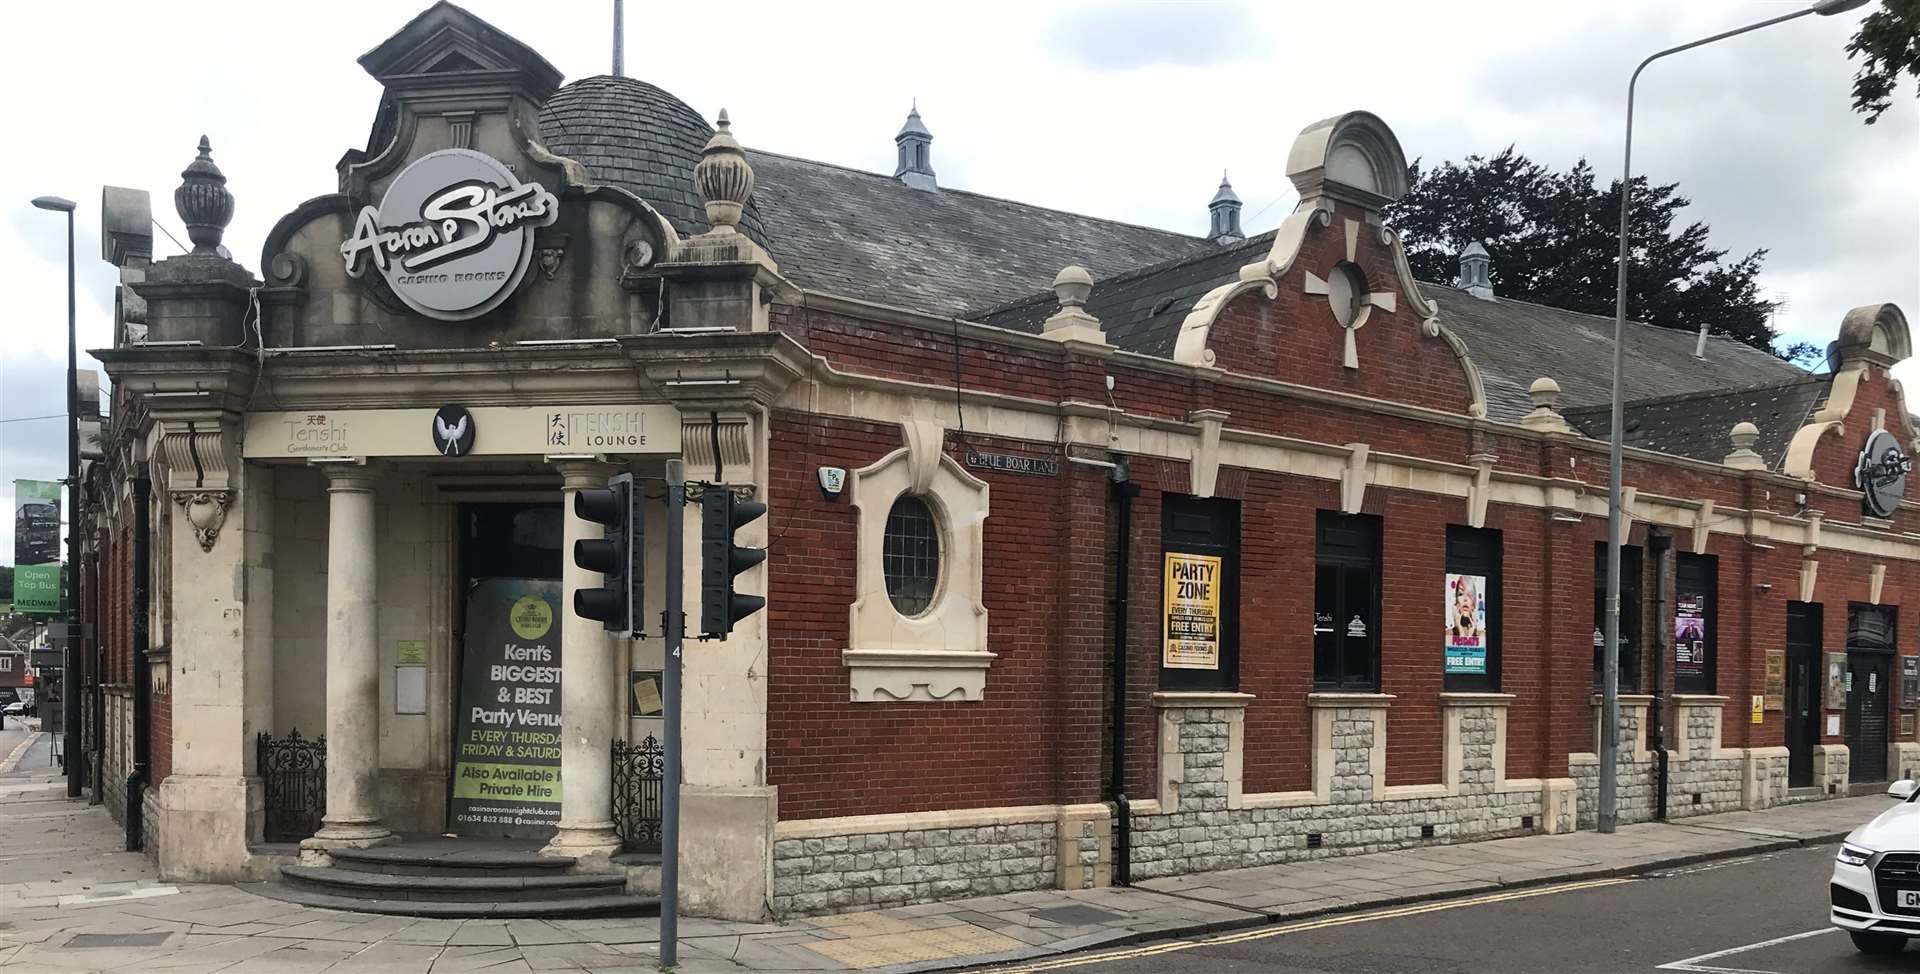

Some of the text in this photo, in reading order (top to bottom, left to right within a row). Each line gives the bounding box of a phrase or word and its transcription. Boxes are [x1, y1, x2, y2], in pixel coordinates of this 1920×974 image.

[398, 271, 506, 285] CASINO ROOMS
[571, 412, 645, 434] TENSHI
[283, 420, 347, 442] Tenshi
[587, 435, 648, 446] LOUNGE
[979, 453, 1055, 473] BLUE BOAR LANE
[24, 570, 50, 581] Open
[1172, 561, 1215, 582] PARTY
[18, 580, 57, 590] Top Bus
[1177, 582, 1210, 600] ZONE
[17, 599, 57, 607] MEDWAY
[1171, 606, 1187, 615] EVERY
[1171, 621, 1190, 632] FREE
[1191, 622, 1213, 634] ENTRY
[504, 643, 552, 662] Kent's
[672, 645, 681, 659] 4
[490, 664, 562, 684] BIGGEST
[497, 686, 553, 705] & BEST
[471, 706, 516, 729] Party
[471, 730, 508, 743] EVERY
[462, 743, 504, 757] FRIDAY
[505, 745, 515, 758] &
[462, 766, 490, 780] Also
[492, 767, 554, 783] Available
[479, 782, 553, 798] Private Hire
[457, 814, 482, 824] 01634
